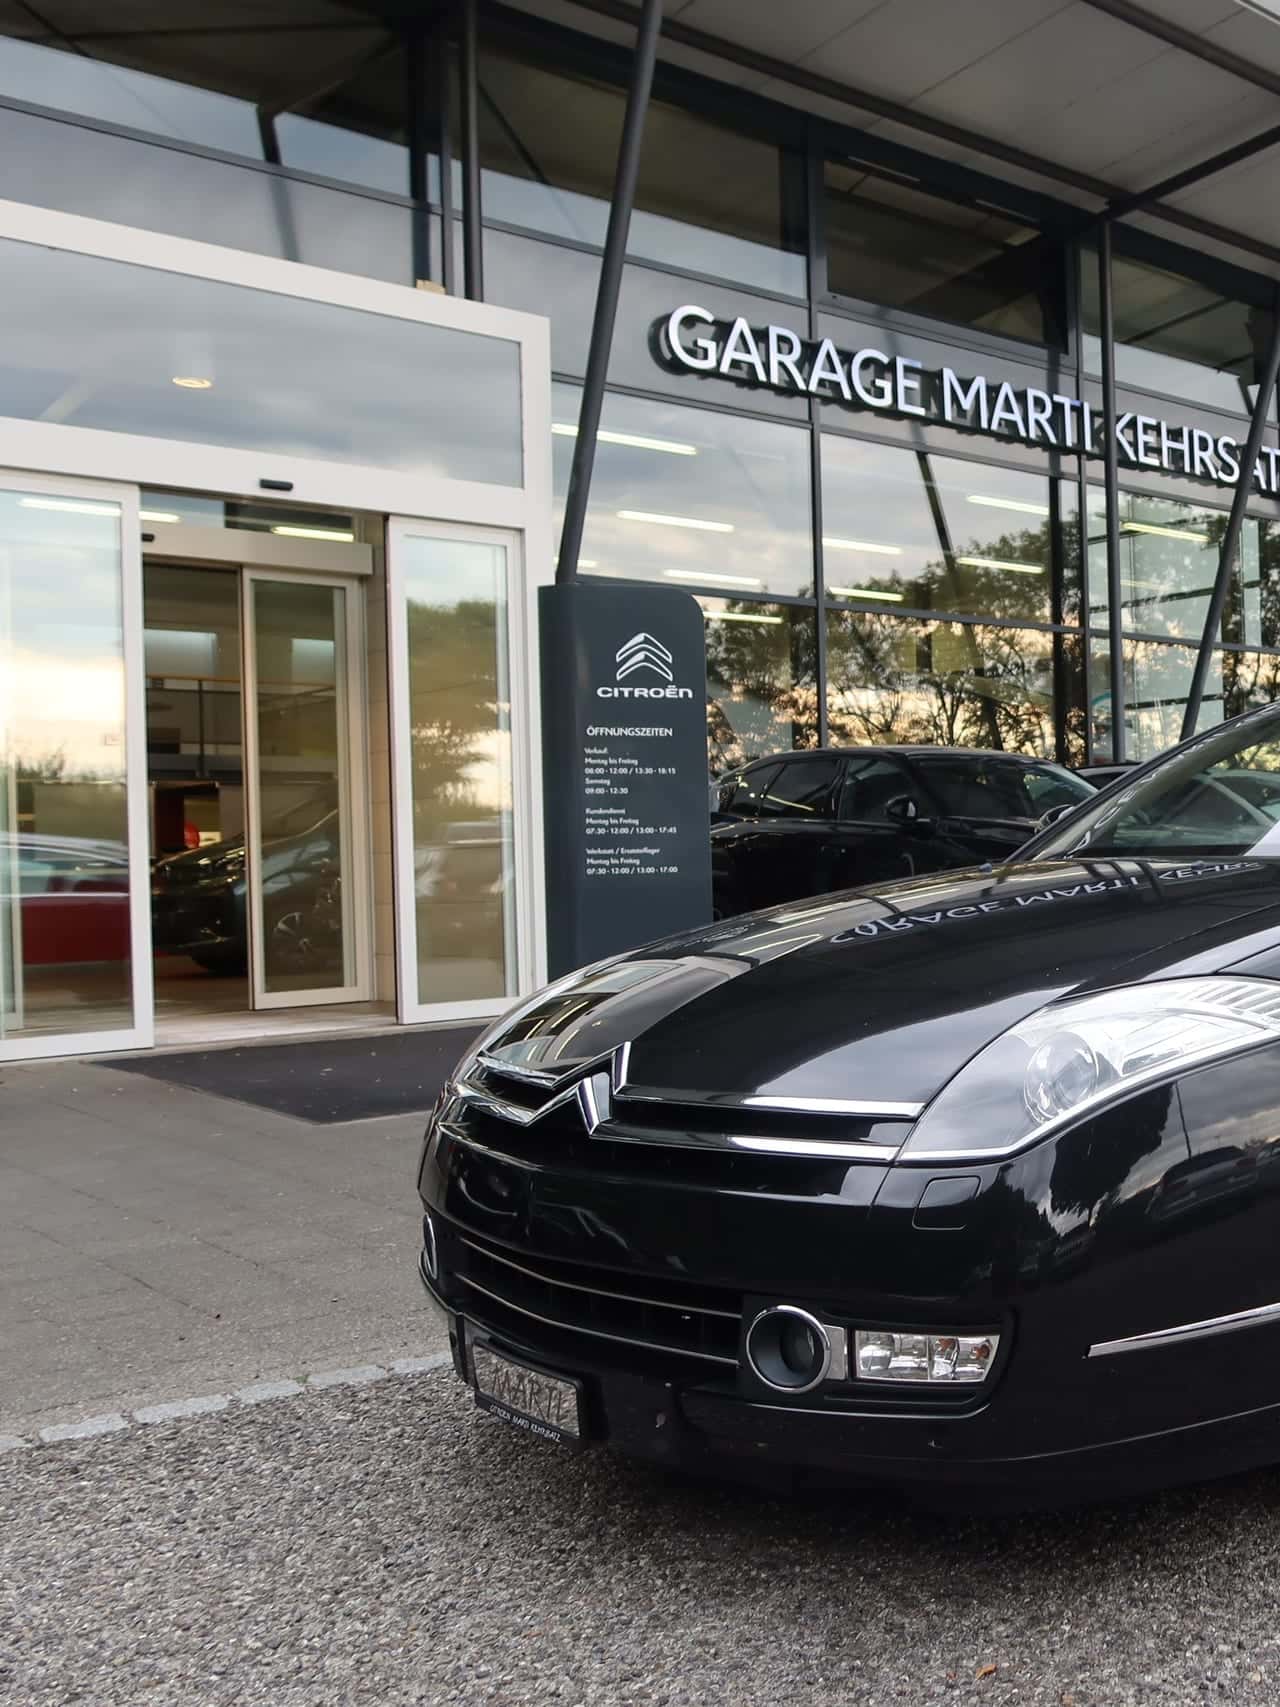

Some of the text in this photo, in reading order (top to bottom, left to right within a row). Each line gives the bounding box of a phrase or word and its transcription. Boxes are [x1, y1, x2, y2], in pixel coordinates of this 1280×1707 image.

[666, 305, 926, 416] GARAGE
[941, 368, 1092, 451] MARTI
[586, 725, 673, 737] ÖFFNUNGSZEITEN
[584, 757, 608, 766] Montag
[618, 757, 638, 766] Freitag
[585, 817, 609, 826] Montag
[619, 817, 639, 826] Freitag
